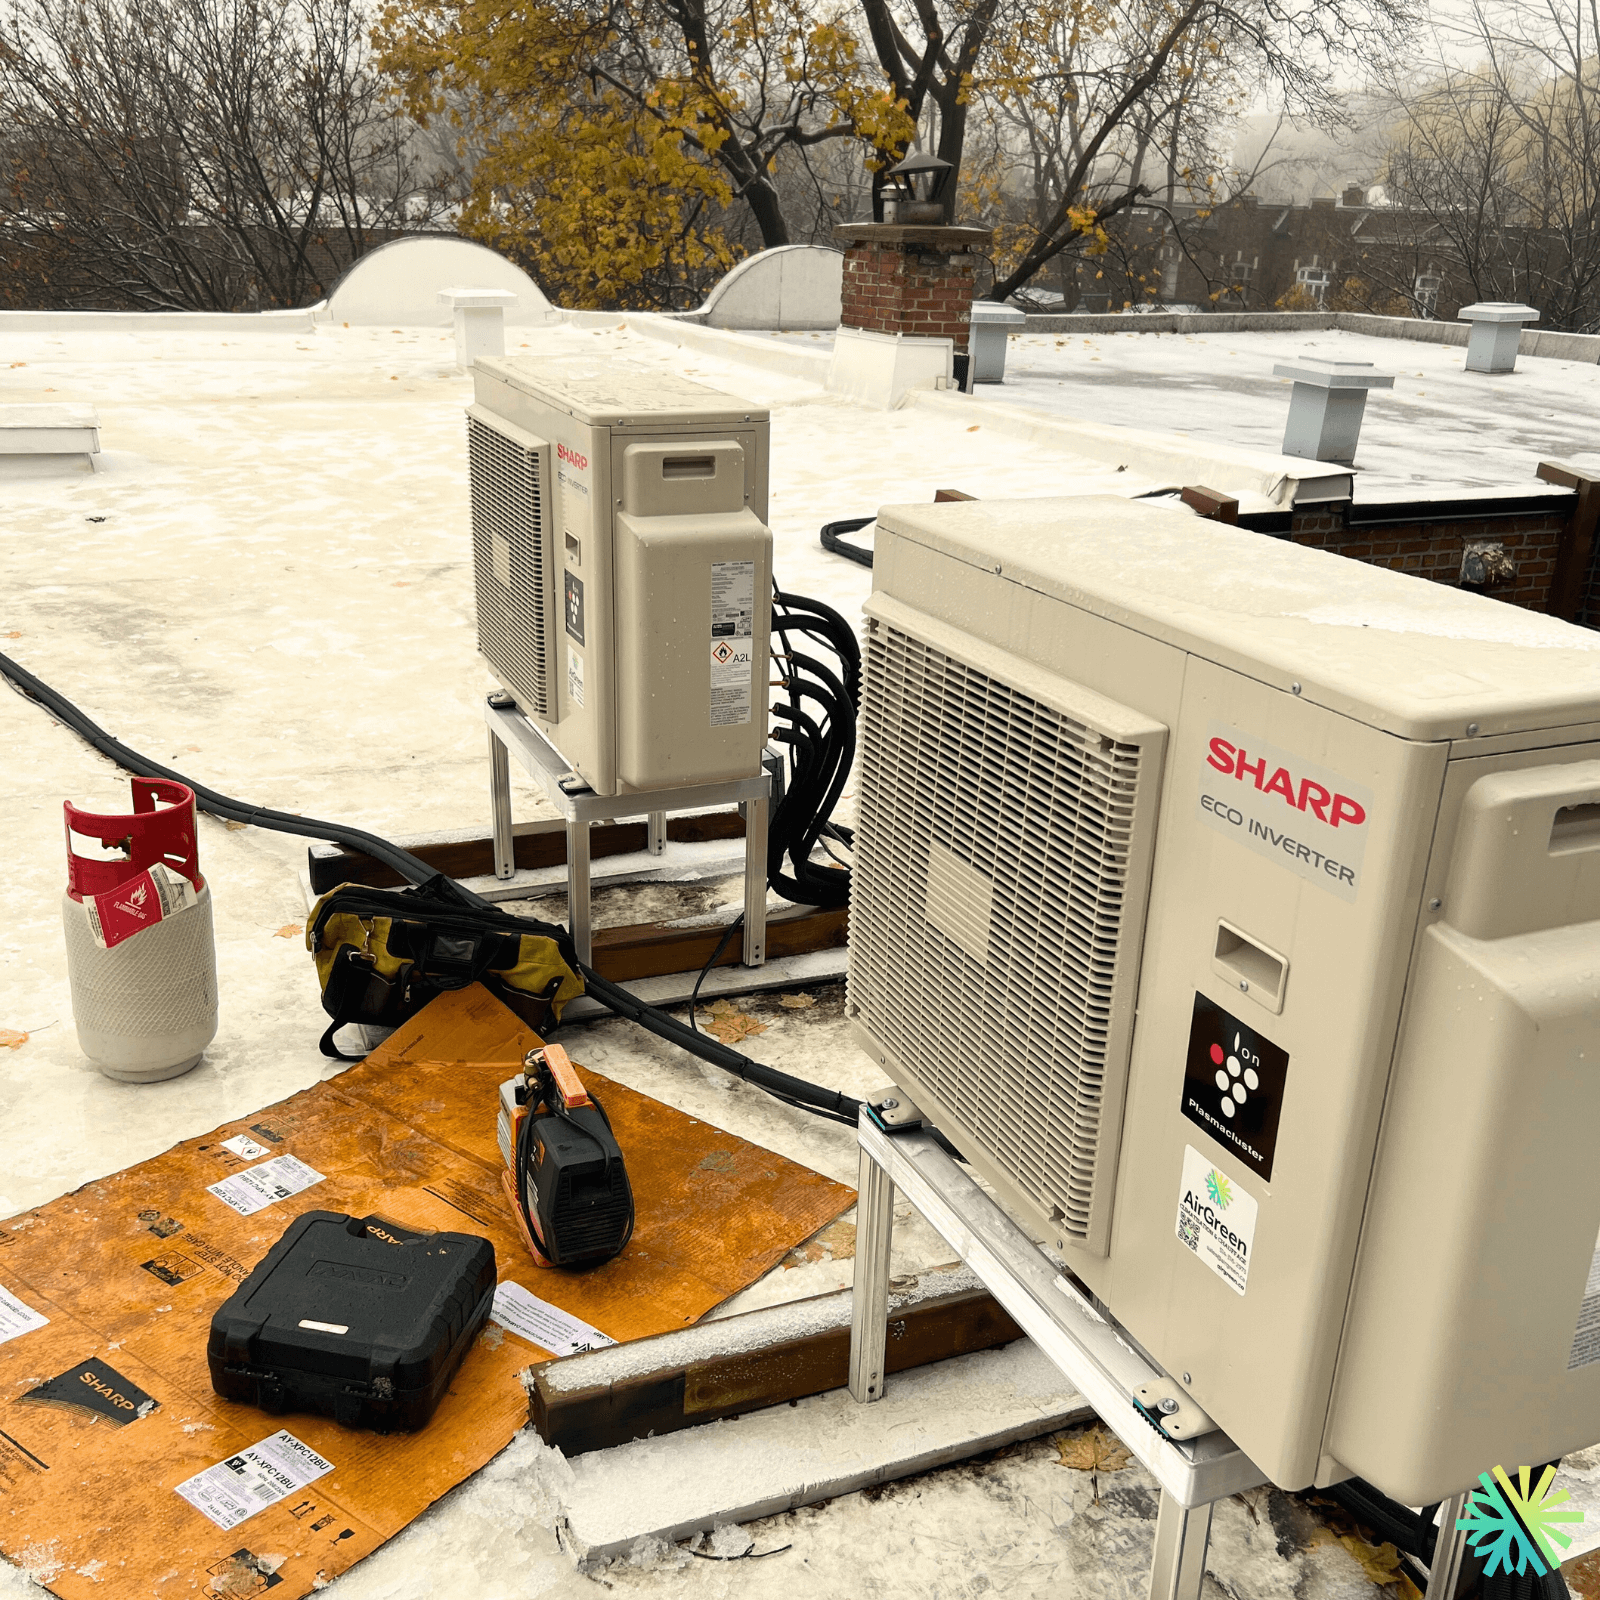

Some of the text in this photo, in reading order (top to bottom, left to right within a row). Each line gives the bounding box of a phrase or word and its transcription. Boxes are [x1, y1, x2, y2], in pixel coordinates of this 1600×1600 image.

[557, 443, 588, 470] SHARP
[733, 653, 751, 663] A2L
[1206, 737, 1366, 828] SHARP
[1201, 794, 1355, 886] ECO INVERTER
[1234, 1031, 1260, 1067] Ion
[1189, 1098, 1264, 1162] Plasmacluster
[1184, 1190, 1247, 1256] AirGreen
[182, 1233, 250, 1277] ANDLE WITH CARE
[194, 1250, 217, 1264] STEP
[213, 1263, 233, 1276] NOT
[79, 1371, 135, 1410] SHARP
[245, 1451, 296, 1489] AY-XPC12BU
[278, 1434, 330, 1470] AY-XPC12BU
